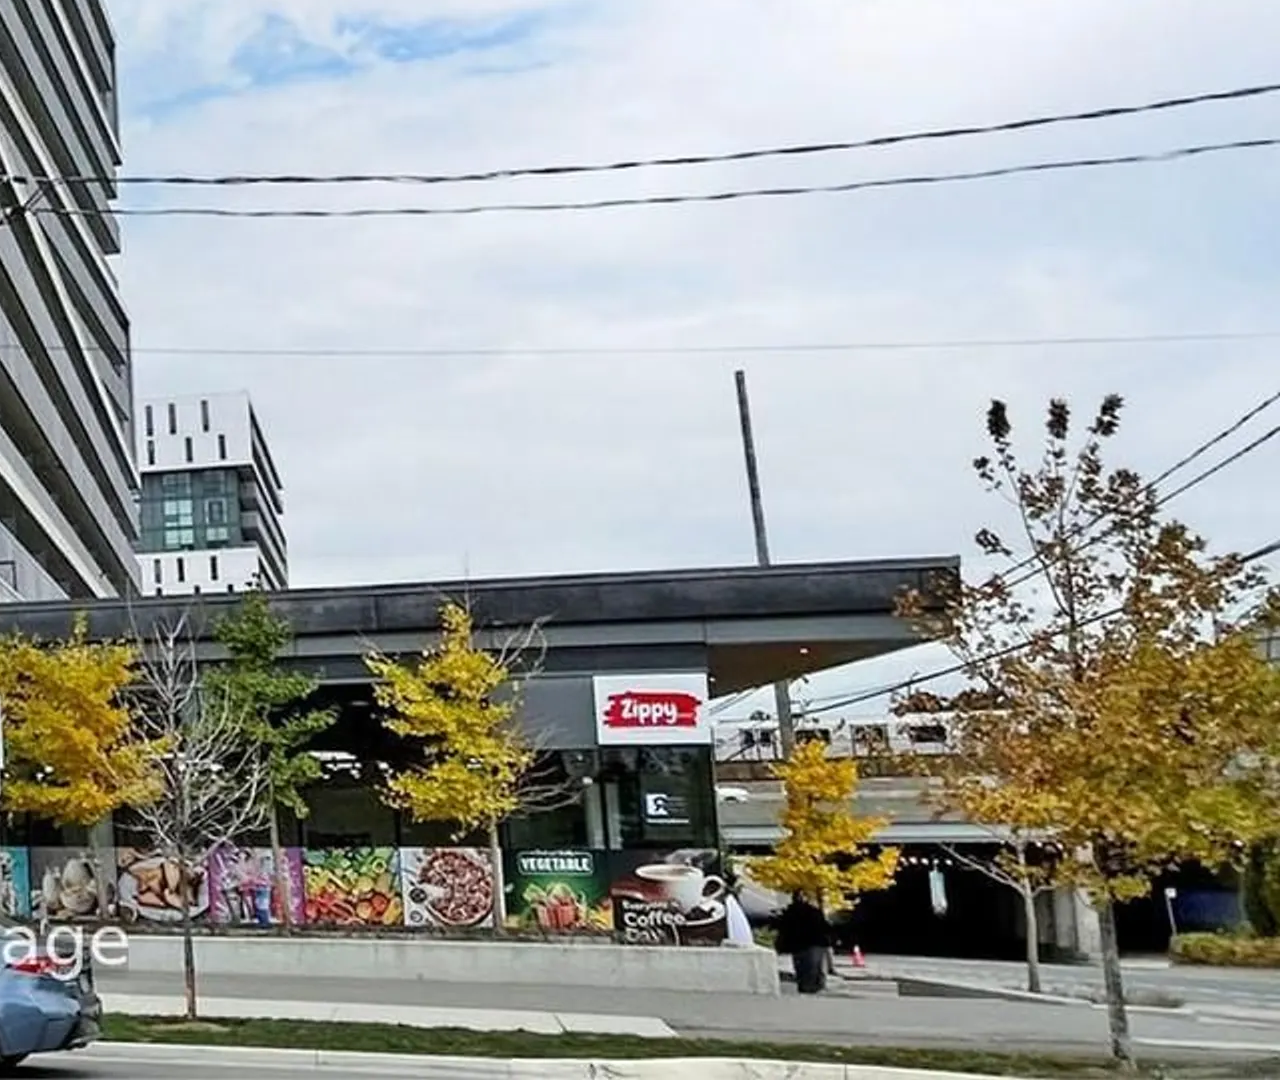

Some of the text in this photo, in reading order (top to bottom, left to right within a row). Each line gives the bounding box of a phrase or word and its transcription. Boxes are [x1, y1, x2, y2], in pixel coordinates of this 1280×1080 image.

[621, 700, 677, 724] Zippy
[521, 858, 591, 871] VEGETABLE
[624, 911, 686, 927] Coffee
